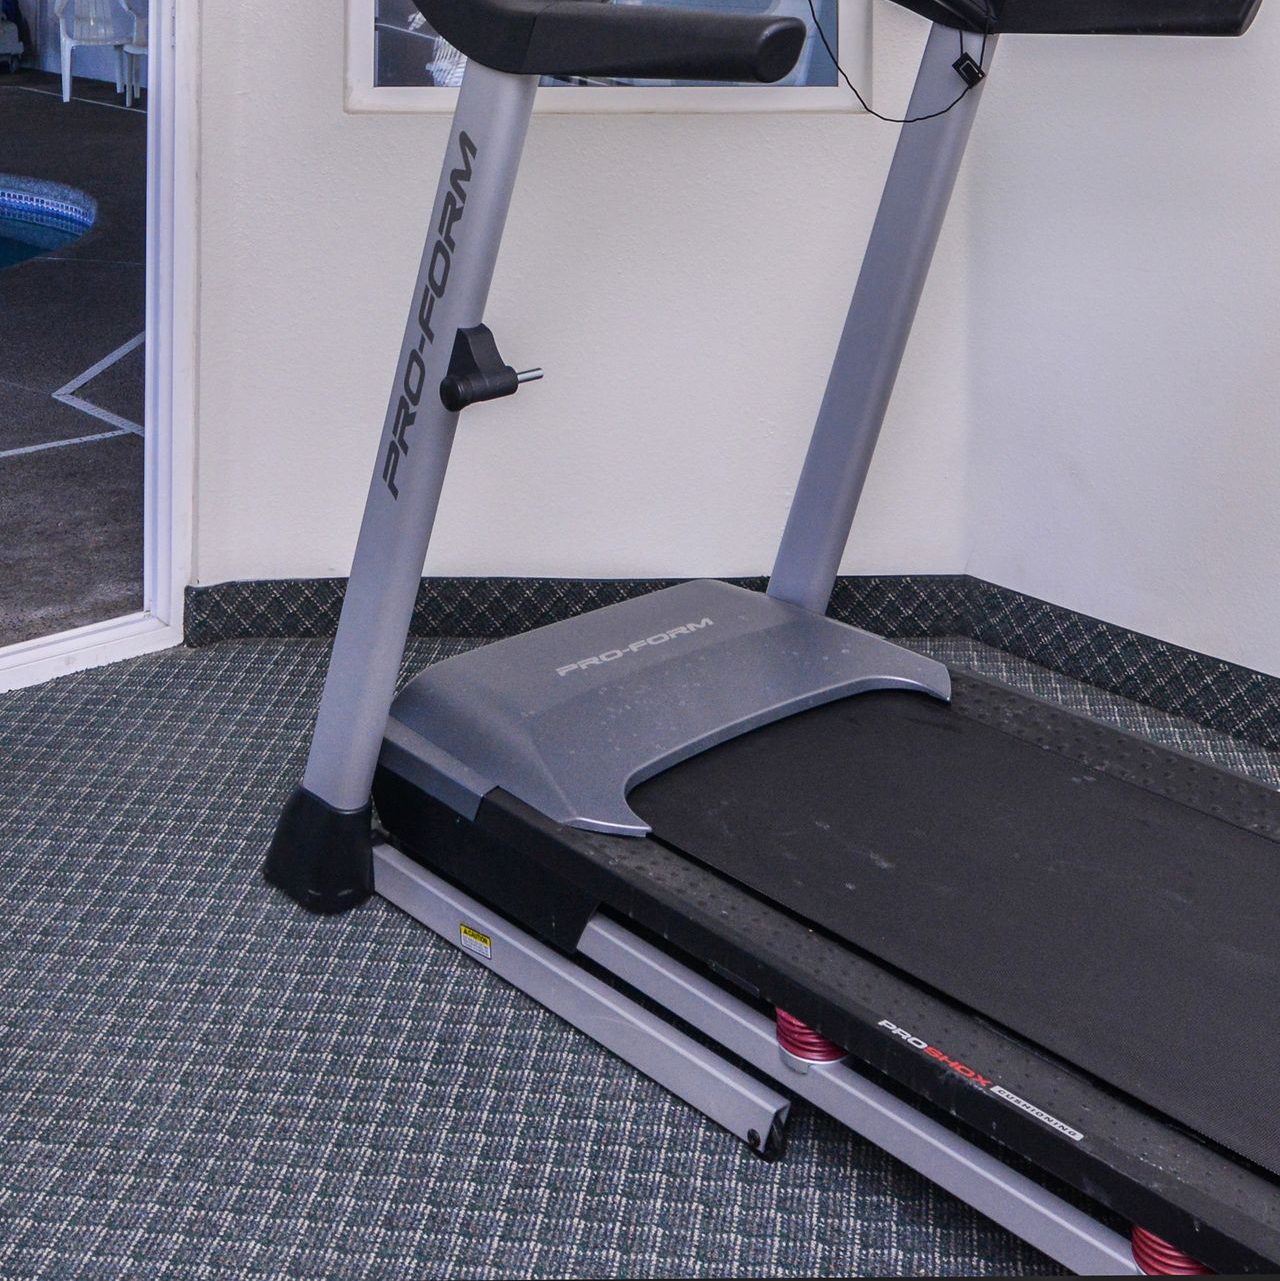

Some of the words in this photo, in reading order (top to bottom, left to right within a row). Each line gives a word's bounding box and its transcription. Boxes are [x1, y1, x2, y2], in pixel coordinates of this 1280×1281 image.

[382, 130, 478, 502] PRO-FORM
[555, 617, 714, 677] PRO-FORM
[997, 1088, 1078, 1137] CUSHIONING
